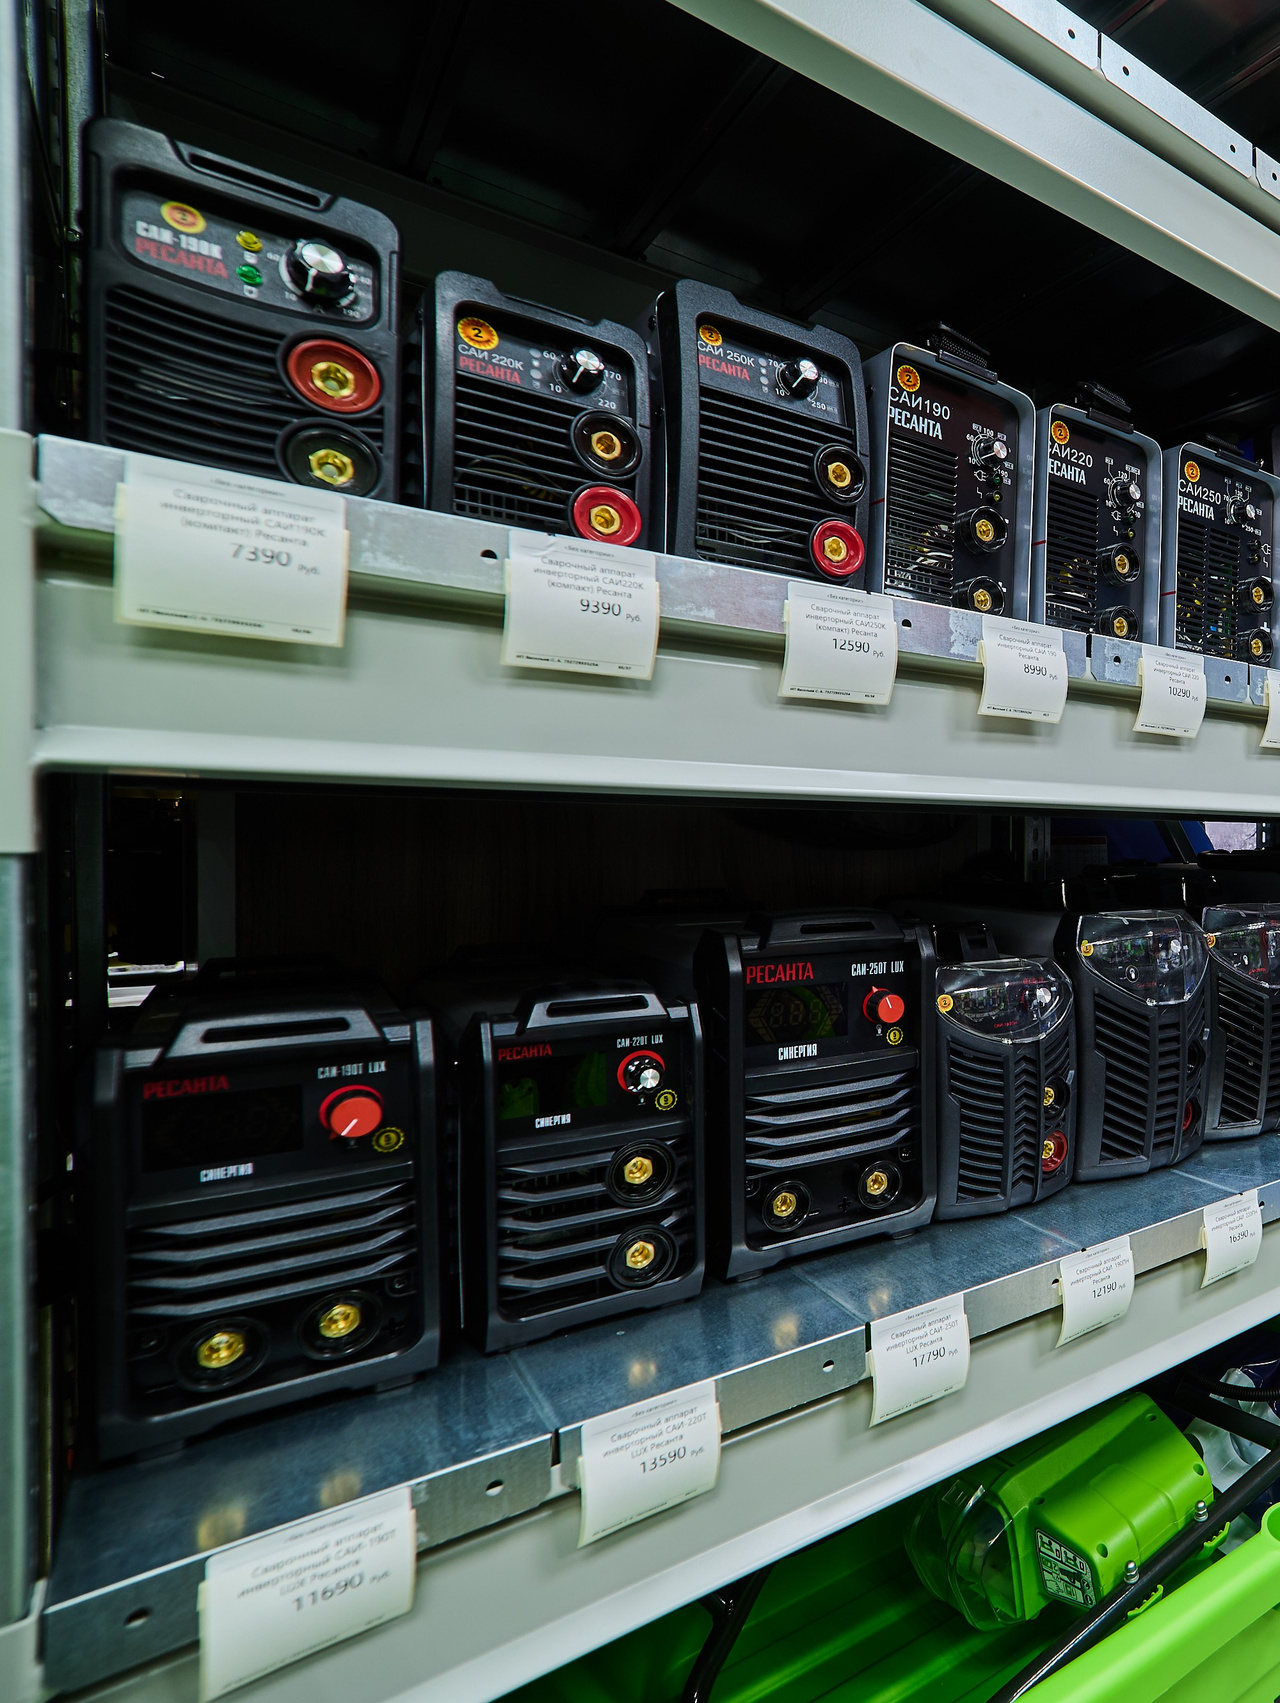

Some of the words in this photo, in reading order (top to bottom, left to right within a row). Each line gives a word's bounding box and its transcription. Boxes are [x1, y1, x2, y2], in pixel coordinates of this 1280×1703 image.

[135, 237, 229, 280] РЕСАНТА
[472, 327, 483, 339] 2
[458, 344, 489, 361] САИ
[491, 353, 525, 371] 220К
[543, 350, 556, 360] 60
[697, 341, 724, 357] САИ
[726, 350, 756, 368] 250К
[459, 356, 521, 385] РЕСАНТА
[604, 369, 622, 381] 170
[699, 354, 750, 381] РЕСАНТА
[905, 373, 912, 383] 2
[549, 383, 562, 393] 10
[776, 388, 785, 396] 10
[598, 398, 616, 409] 220
[811, 400, 827, 411] 250
[889, 386, 950, 421] САИ190
[1049, 441, 1094, 468] АИ220
[1049, 458, 1087, 485] ЕСАНТА
[1178, 479, 1222, 505] САИ250
[1178, 495, 1215, 521] РЕСАНТА
[230, 542, 291, 567] 7390
[541, 556, 597, 572] Сварочный
[599, 566, 636, 580] аппарат
[533, 568, 600, 584] инверторный
[602, 577, 644, 590] САИ220К
[547, 581, 594, 594] (компакт)
[596, 586, 632, 599] Ресанта
[580, 598, 621, 617] 9390
[811, 604, 851, 616] Сварочный
[853, 611, 880, 621] аппарат
[805, 613, 854, 625] инверторный
[855, 619, 886, 630] САИ250К
[816, 624, 850, 635] (компакт)
[851, 628, 878, 638] Ресанта
[832, 638, 870, 653] 12590
[999, 634, 1030, 645] Сварочный
[1031, 640, 1052, 649] аппарат
[1018, 652, 1039, 661] Ресанта
[1023, 663, 1047, 677] 8990
[1168, 686, 1191, 699] 10290
[746, 962, 814, 985] РЕСАНТА
[851, 962, 887, 977] САИ-250Т
[891, 960, 905, 973] LUX
[498, 1044, 552, 1061] РЕСАНТА
[616, 1035, 648, 1048] САИ-220Т
[651, 1034, 664, 1044] LUX
[778, 1043, 818, 1061] СИНЕРГИЯ
[143, 1075, 229, 1100] РЕСАНТА
[317, 1062, 363, 1079] САИ-190Т
[368, 1060, 387, 1074] LUX
[535, 1113, 571, 1129] СИНЕРГИЯ
[200, 1162, 254, 1183] СИНЕРГИЯ
[1229, 1229, 1249, 1244] 16390
[1076, 1260, 1103, 1276] Сварочный
[1103, 1254, 1122, 1265] аппарат
[1092, 1274, 1111, 1286] Ресанта
[1092, 1282, 1117, 1299] 12190
[886, 1331, 928, 1352] инверторный
[930, 1320, 959, 1336] САИ-250Т
[891, 1322, 926, 1340] Сварочный
[928, 1314, 952, 1328] аппарат
[906, 1345, 918, 1355] LUX
[919, 1336, 943, 1350] Ресанта
[912, 1346, 946, 1367] 17790
[603, 1430, 664, 1458] инверторный
[665, 1412, 708, 1434] САИ-220Т
[610, 1419, 662, 1443] Сварочный
[664, 1406, 698, 1425] аппарат
[631, 1447, 648, 1459] LUX
[650, 1433, 684, 1450] Ресанта
[640, 1446, 687, 1474] 13590
[293, 1572, 365, 1612] 11690
